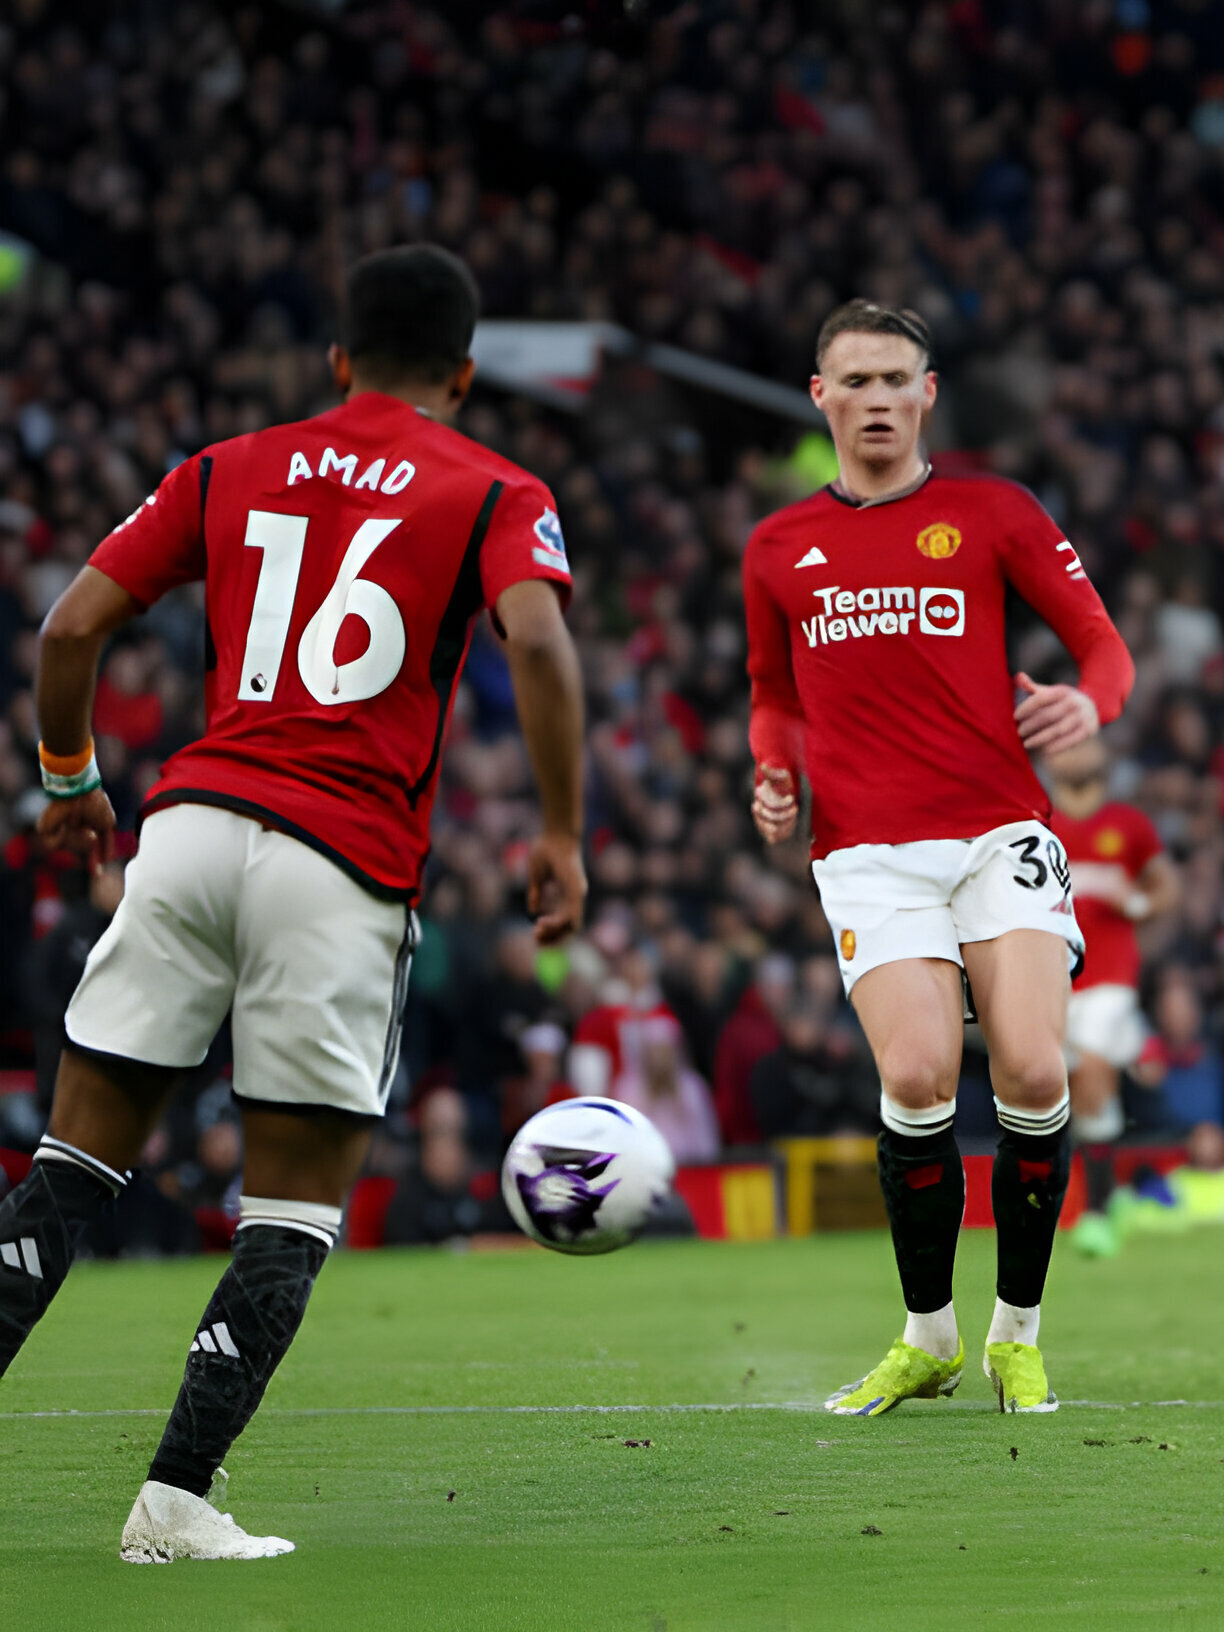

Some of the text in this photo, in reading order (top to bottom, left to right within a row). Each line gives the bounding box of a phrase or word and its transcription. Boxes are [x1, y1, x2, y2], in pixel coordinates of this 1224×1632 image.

[286, 446, 417, 495] AMAD
[237, 509, 407, 706] 16
[812, 585, 916, 617] Team
